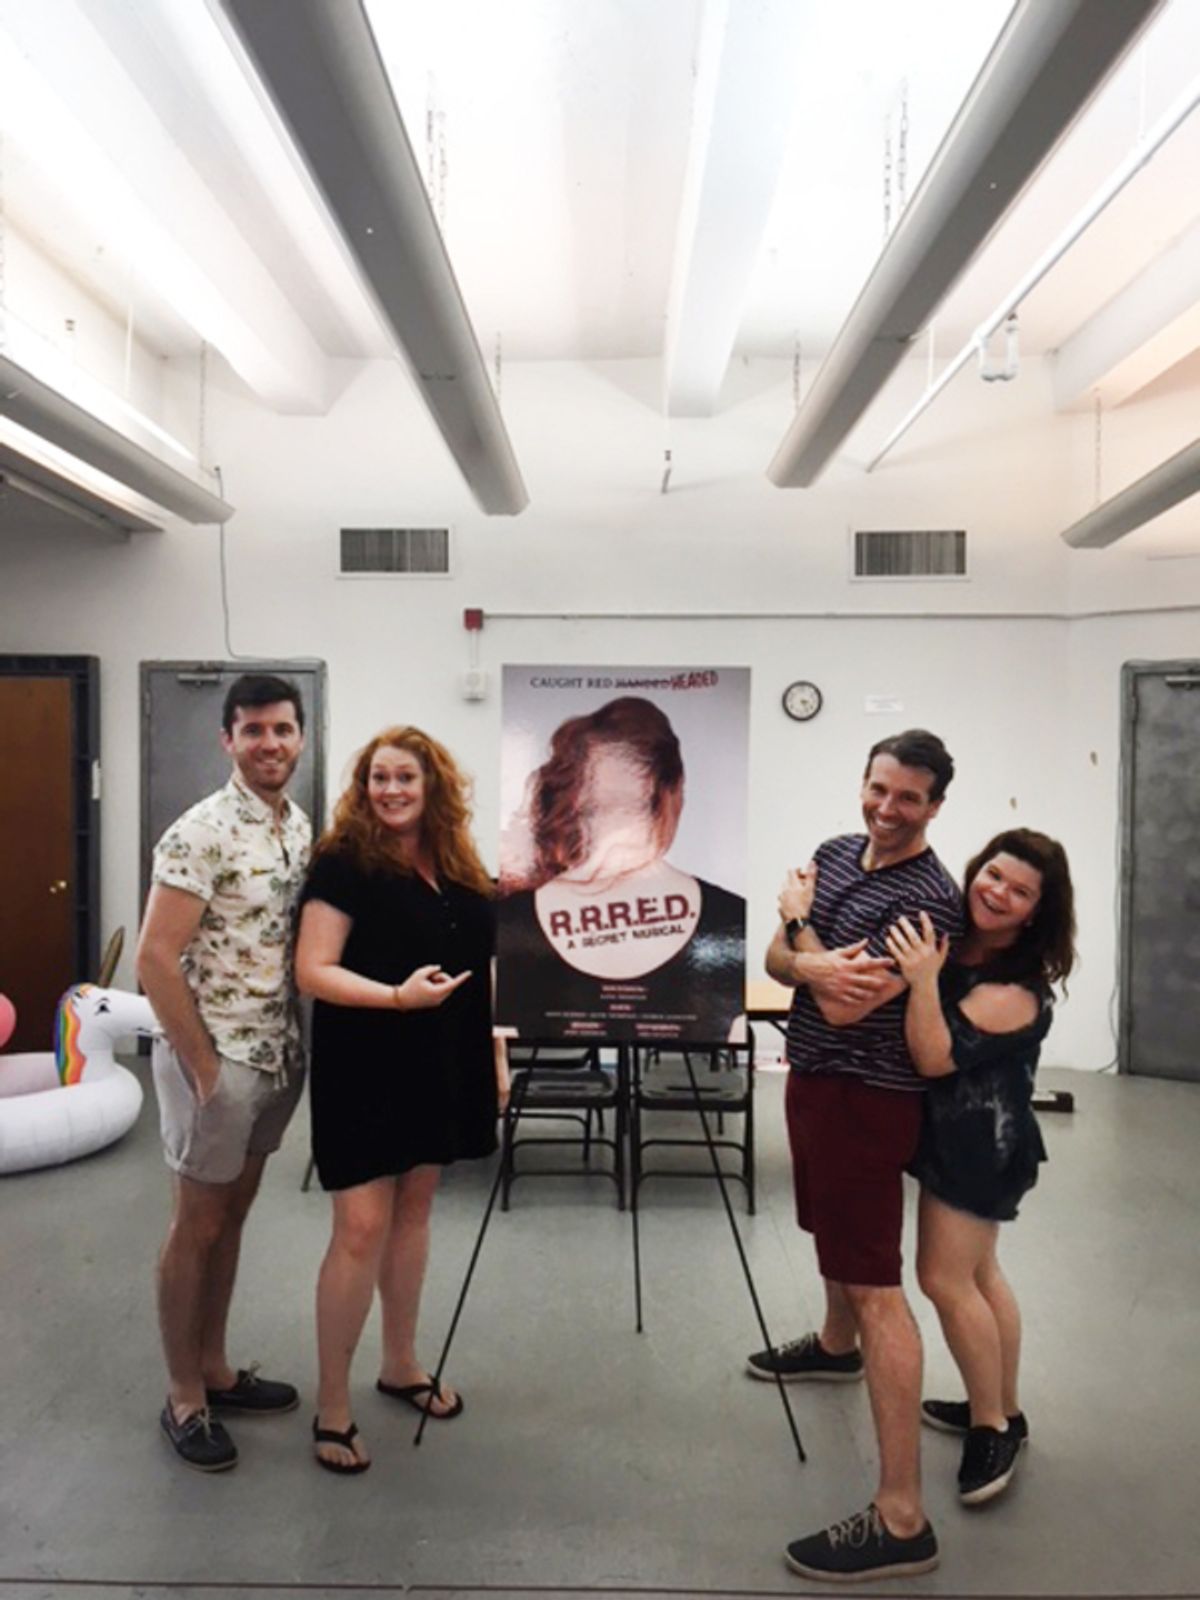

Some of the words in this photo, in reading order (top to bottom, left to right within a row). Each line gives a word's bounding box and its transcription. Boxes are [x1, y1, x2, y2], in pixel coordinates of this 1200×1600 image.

[530, 677, 583, 689] CAUGHT
[587, 677, 612, 689] RED
[567, 939, 577, 950] A
[582, 932, 627, 948] SECRET
[632, 923, 685, 939] MUSICAL
